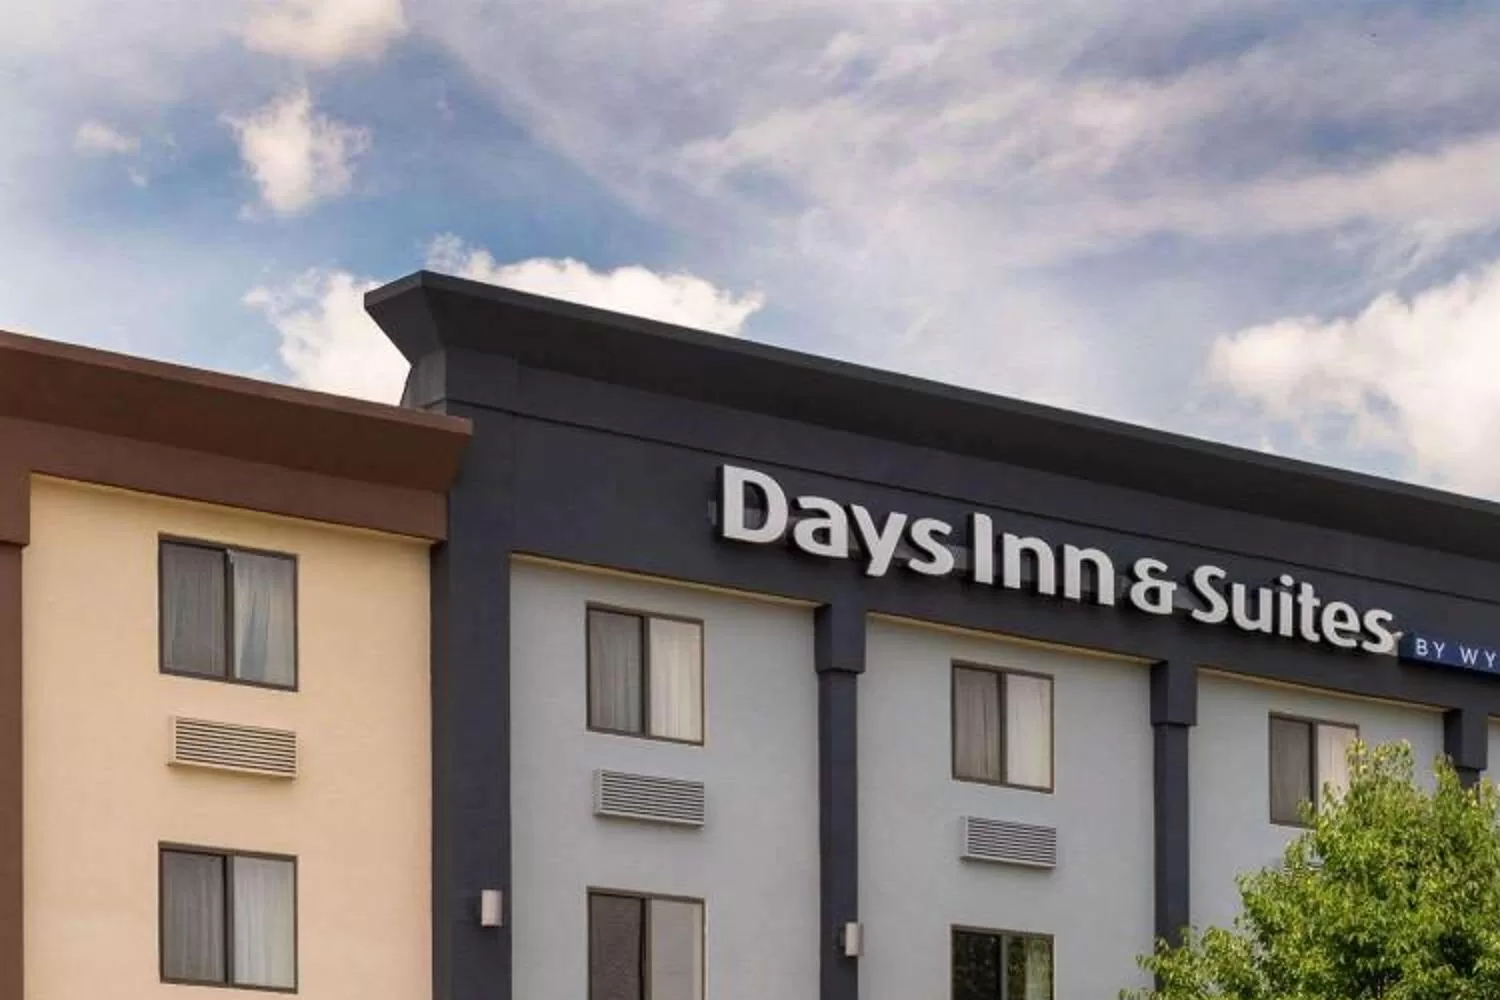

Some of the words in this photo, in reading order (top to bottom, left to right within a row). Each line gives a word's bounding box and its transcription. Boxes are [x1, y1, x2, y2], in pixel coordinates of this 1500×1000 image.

[720, 464, 954, 577] Days
[973, 512, 1116, 607] Inn
[1130, 558, 1177, 616] &
[1191, 565, 1397, 656] Suites
[1415, 637, 1446, 658] BY
